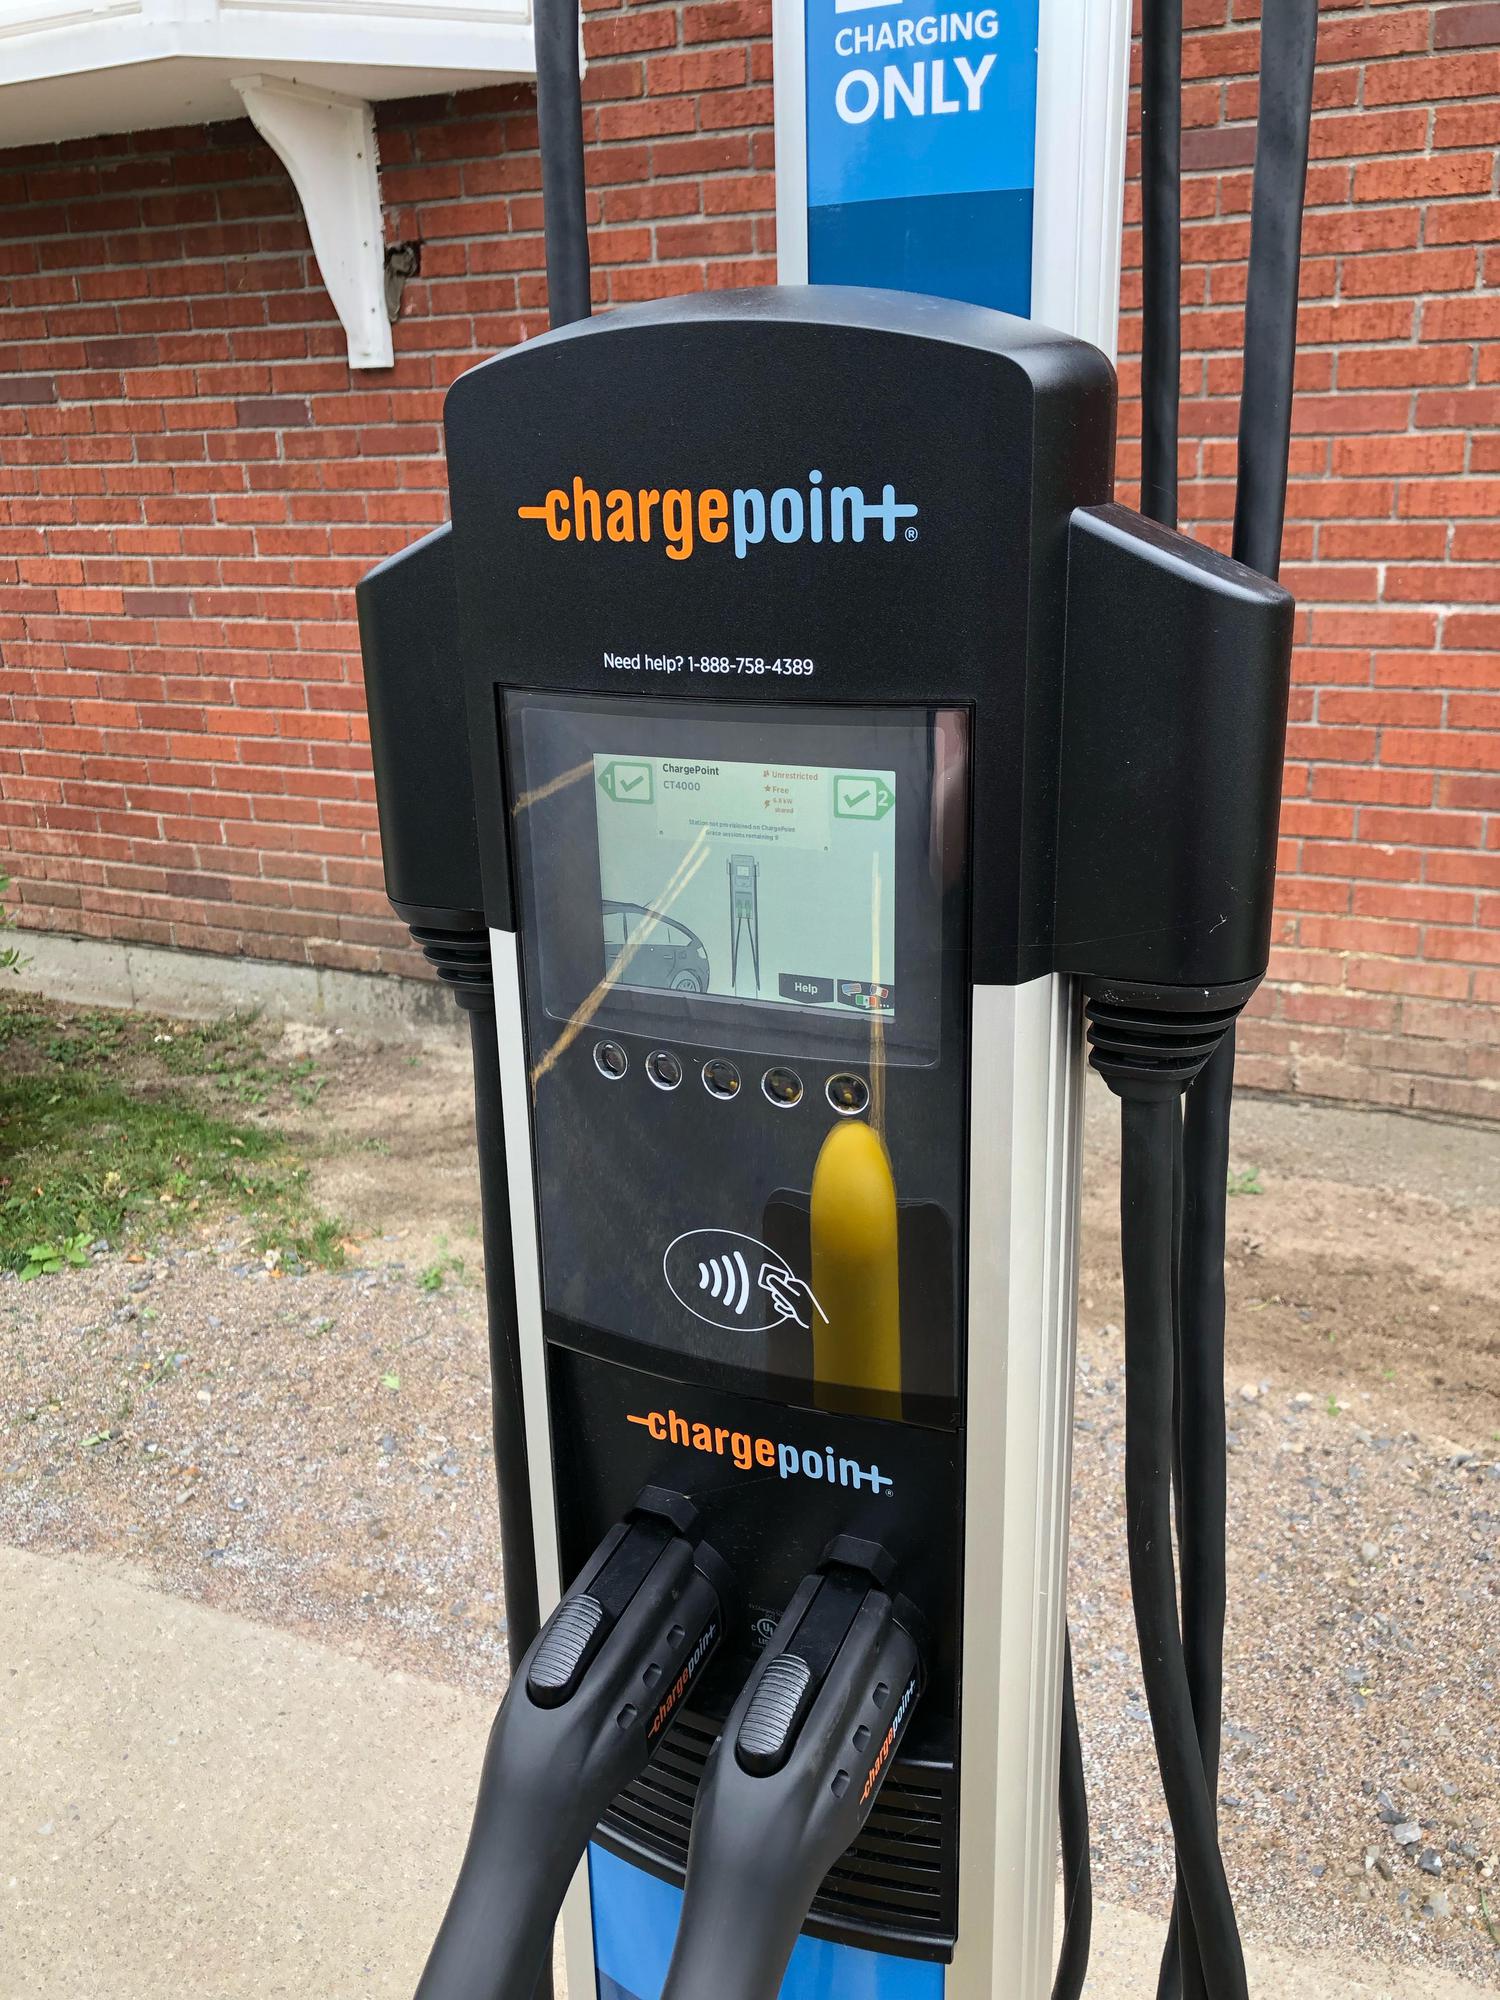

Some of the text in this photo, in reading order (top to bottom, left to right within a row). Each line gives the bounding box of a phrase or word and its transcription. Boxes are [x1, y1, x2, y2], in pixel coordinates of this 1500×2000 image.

[834, 9, 999, 57] CHARGING
[834, 54, 998, 124] ONLY
[603, 652, 814, 676] Need help? 1-888-758-4389
[662, 763, 720, 777] ChargePoint
[772, 770, 819, 781] Unrestricted
[663, 780, 701, 792] CT4000
[772, 785, 790, 794] Free
[878, 789, 890, 807] 2
[794, 981, 818, 995] Help
